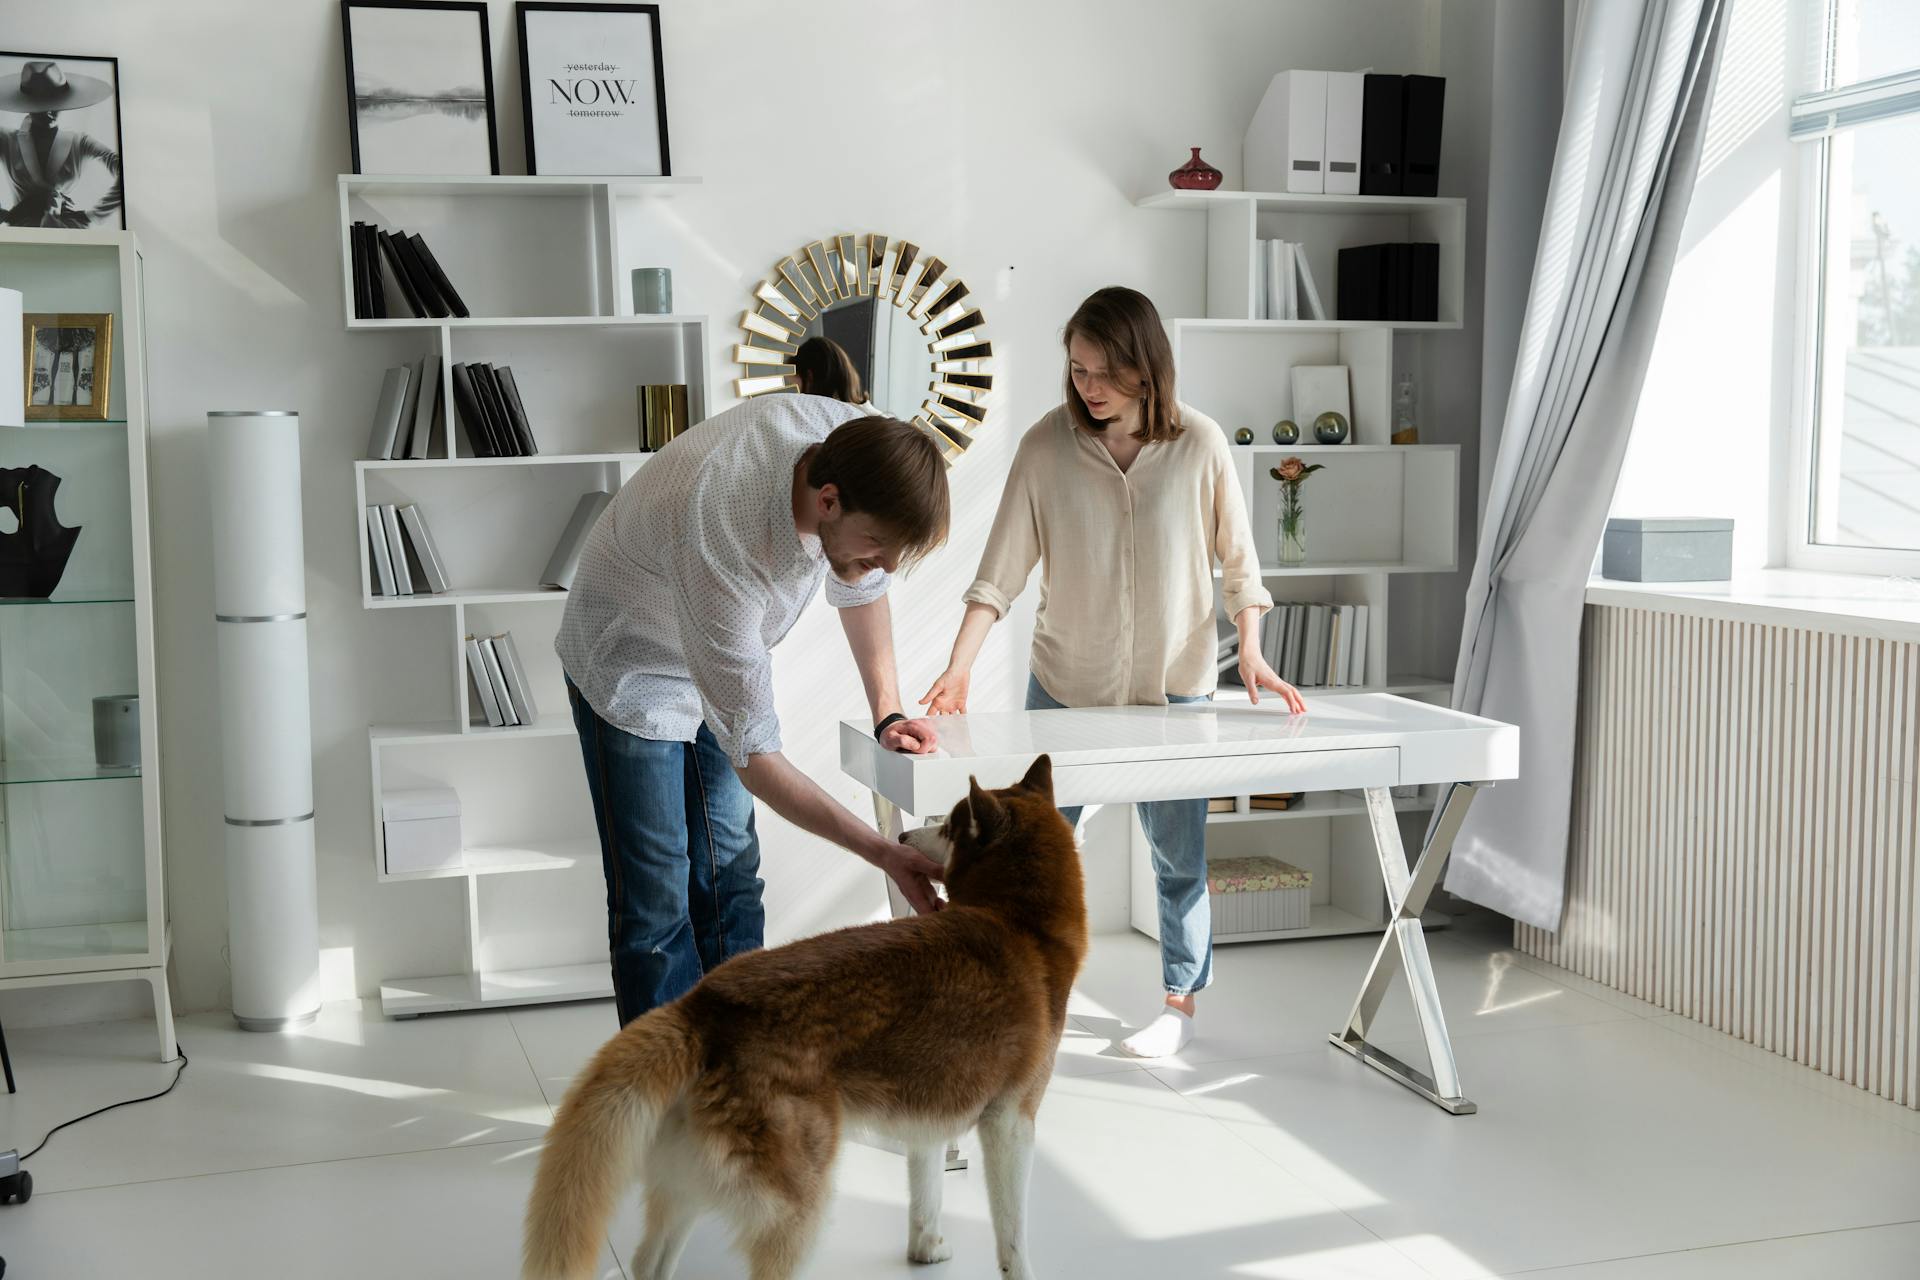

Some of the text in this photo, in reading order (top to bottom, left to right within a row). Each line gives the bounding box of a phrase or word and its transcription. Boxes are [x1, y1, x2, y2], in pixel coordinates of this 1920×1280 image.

[567, 62, 617, 73] yesterday
[547, 78, 638, 105] NOW.
[569, 109, 621, 118] tomorrow
